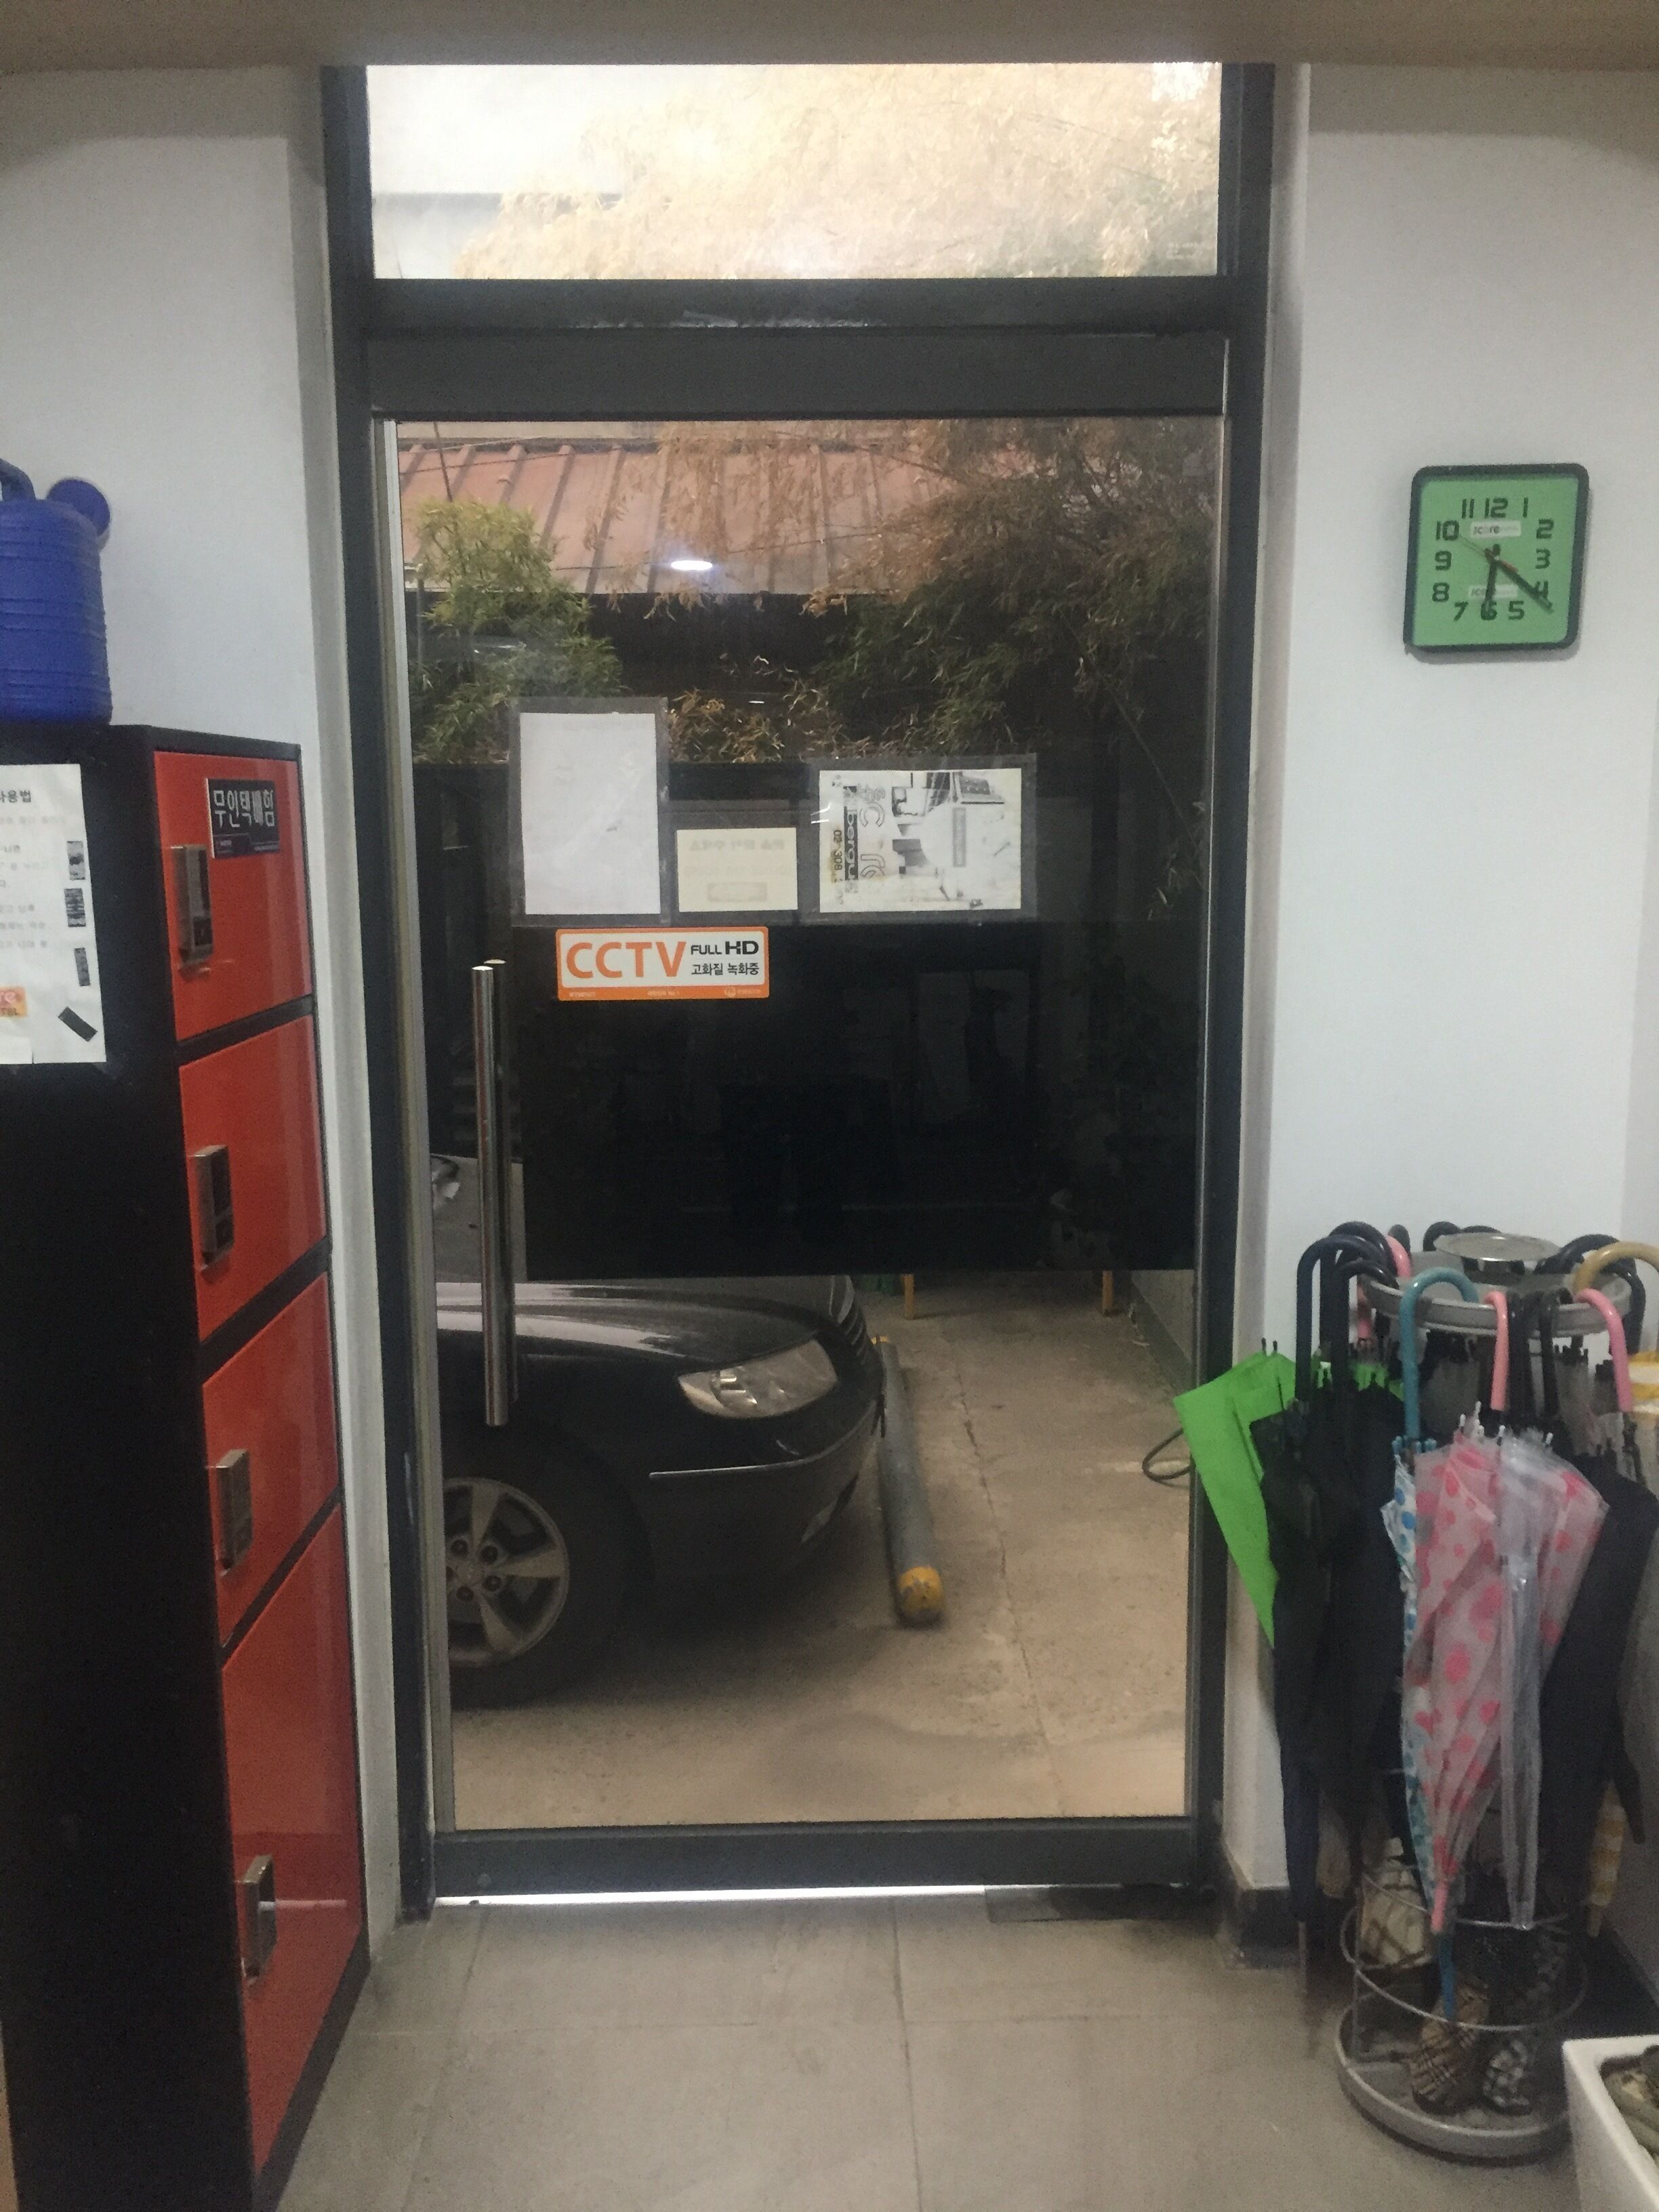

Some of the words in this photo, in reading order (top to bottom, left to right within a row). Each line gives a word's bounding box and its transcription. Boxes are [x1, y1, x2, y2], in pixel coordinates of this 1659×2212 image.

[1462, 498, 1475, 518] 11
[1484, 497, 1509, 518] 12
[1523, 497, 1528, 518] 1
[1435, 520, 1460, 541] 10
[1536, 518, 1554, 539] 2
[1435, 551, 1452, 571] 9
[1535, 548, 1551, 569] 3
[1432, 582, 1450, 602] 8
[1454, 601, 1469, 621] 7
[1481, 601, 1498, 621] 6
[1508, 600, 1525, 620] 5
[213, 790, 274, 827] 무인택배함
[691, 945, 722, 955] FULL
[725, 941, 759, 955] HD
[567, 941, 687, 979] CCTV
[691, 963, 723, 976] 고화질
[727, 962, 760, 975] 녹화중
